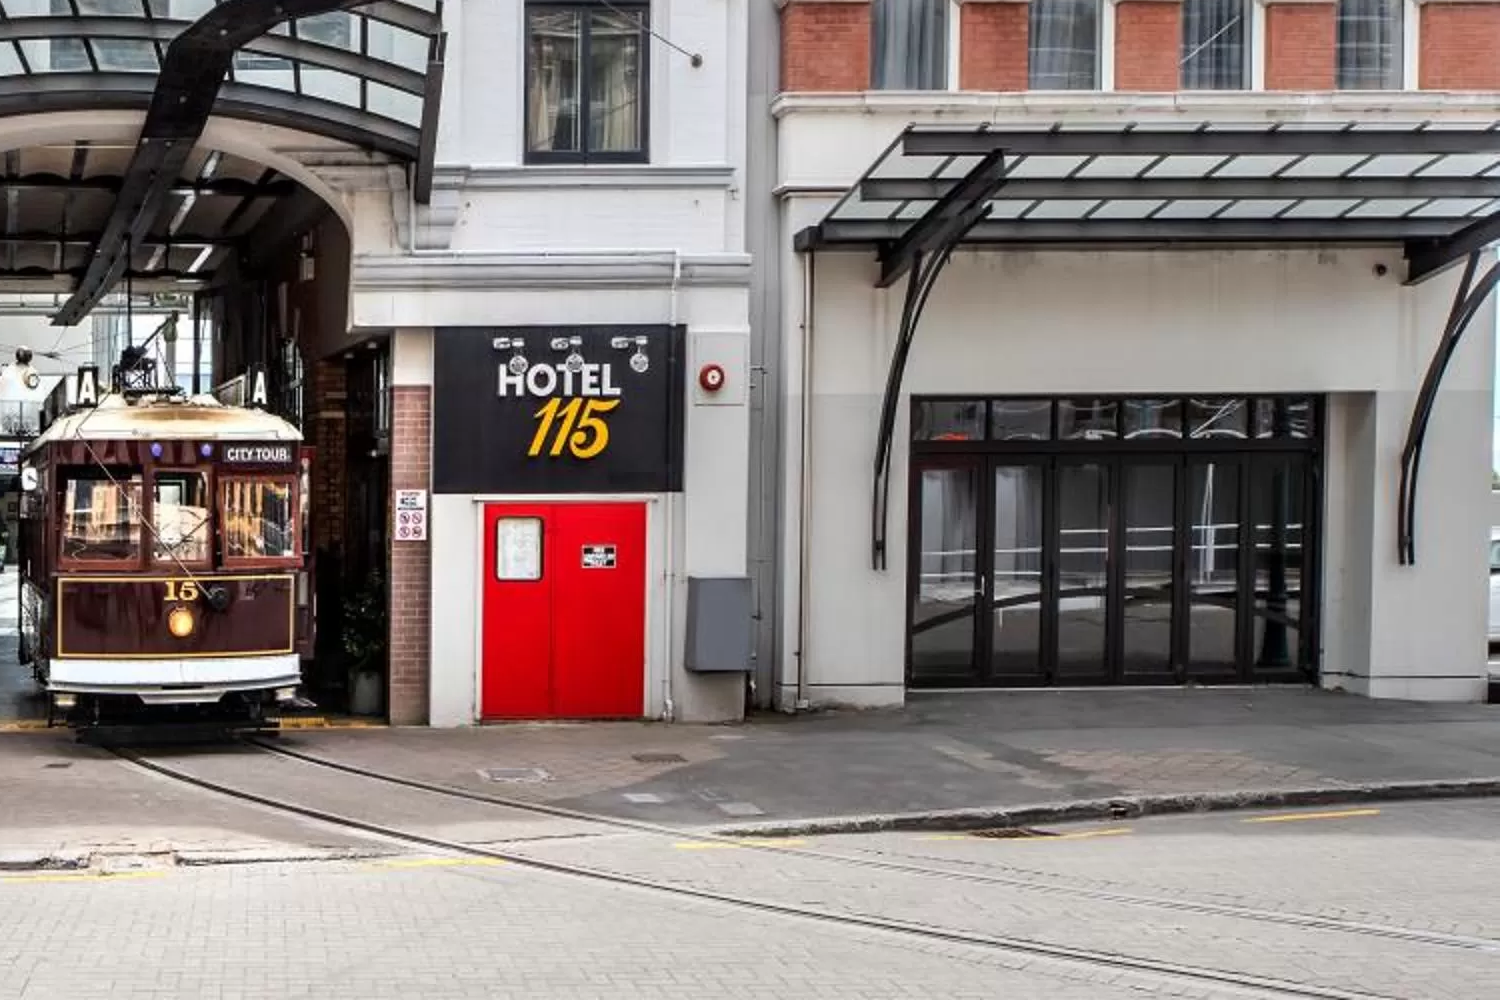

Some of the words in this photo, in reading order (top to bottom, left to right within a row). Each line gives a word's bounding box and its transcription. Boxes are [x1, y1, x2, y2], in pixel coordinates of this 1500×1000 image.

[80, 371, 97, 404] A
[253, 371, 267, 405] A
[498, 363, 621, 397] HOTEL
[528, 397, 620, 459] 115
[227, 448, 252, 461] CITY
[163, 580, 199, 601] 15
